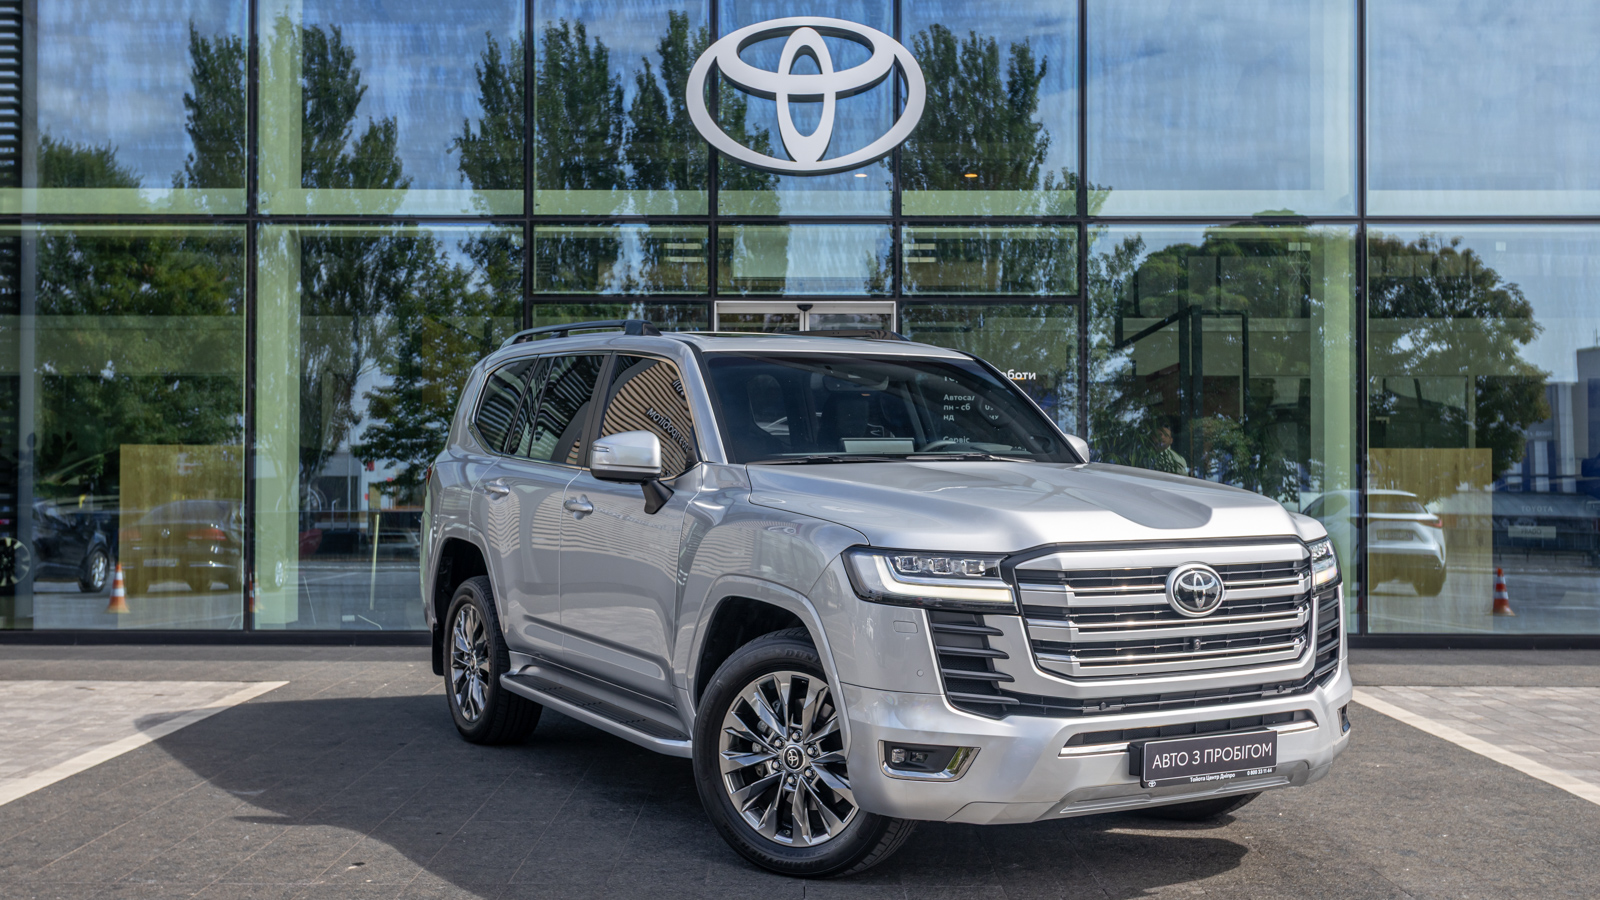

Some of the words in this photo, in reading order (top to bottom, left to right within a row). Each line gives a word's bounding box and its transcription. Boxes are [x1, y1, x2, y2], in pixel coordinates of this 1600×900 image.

[1002, 368, 1036, 380] боти
[960, 403, 971, 411] сб
[1521, 505, 1553, 513] TOYOTA
[1152, 751, 1189, 769] АВТО
[1192, 750, 1200, 765] З
[1204, 742, 1272, 763] ПРОБІГОМ
[1220, 772, 1236, 780] Дніпро
